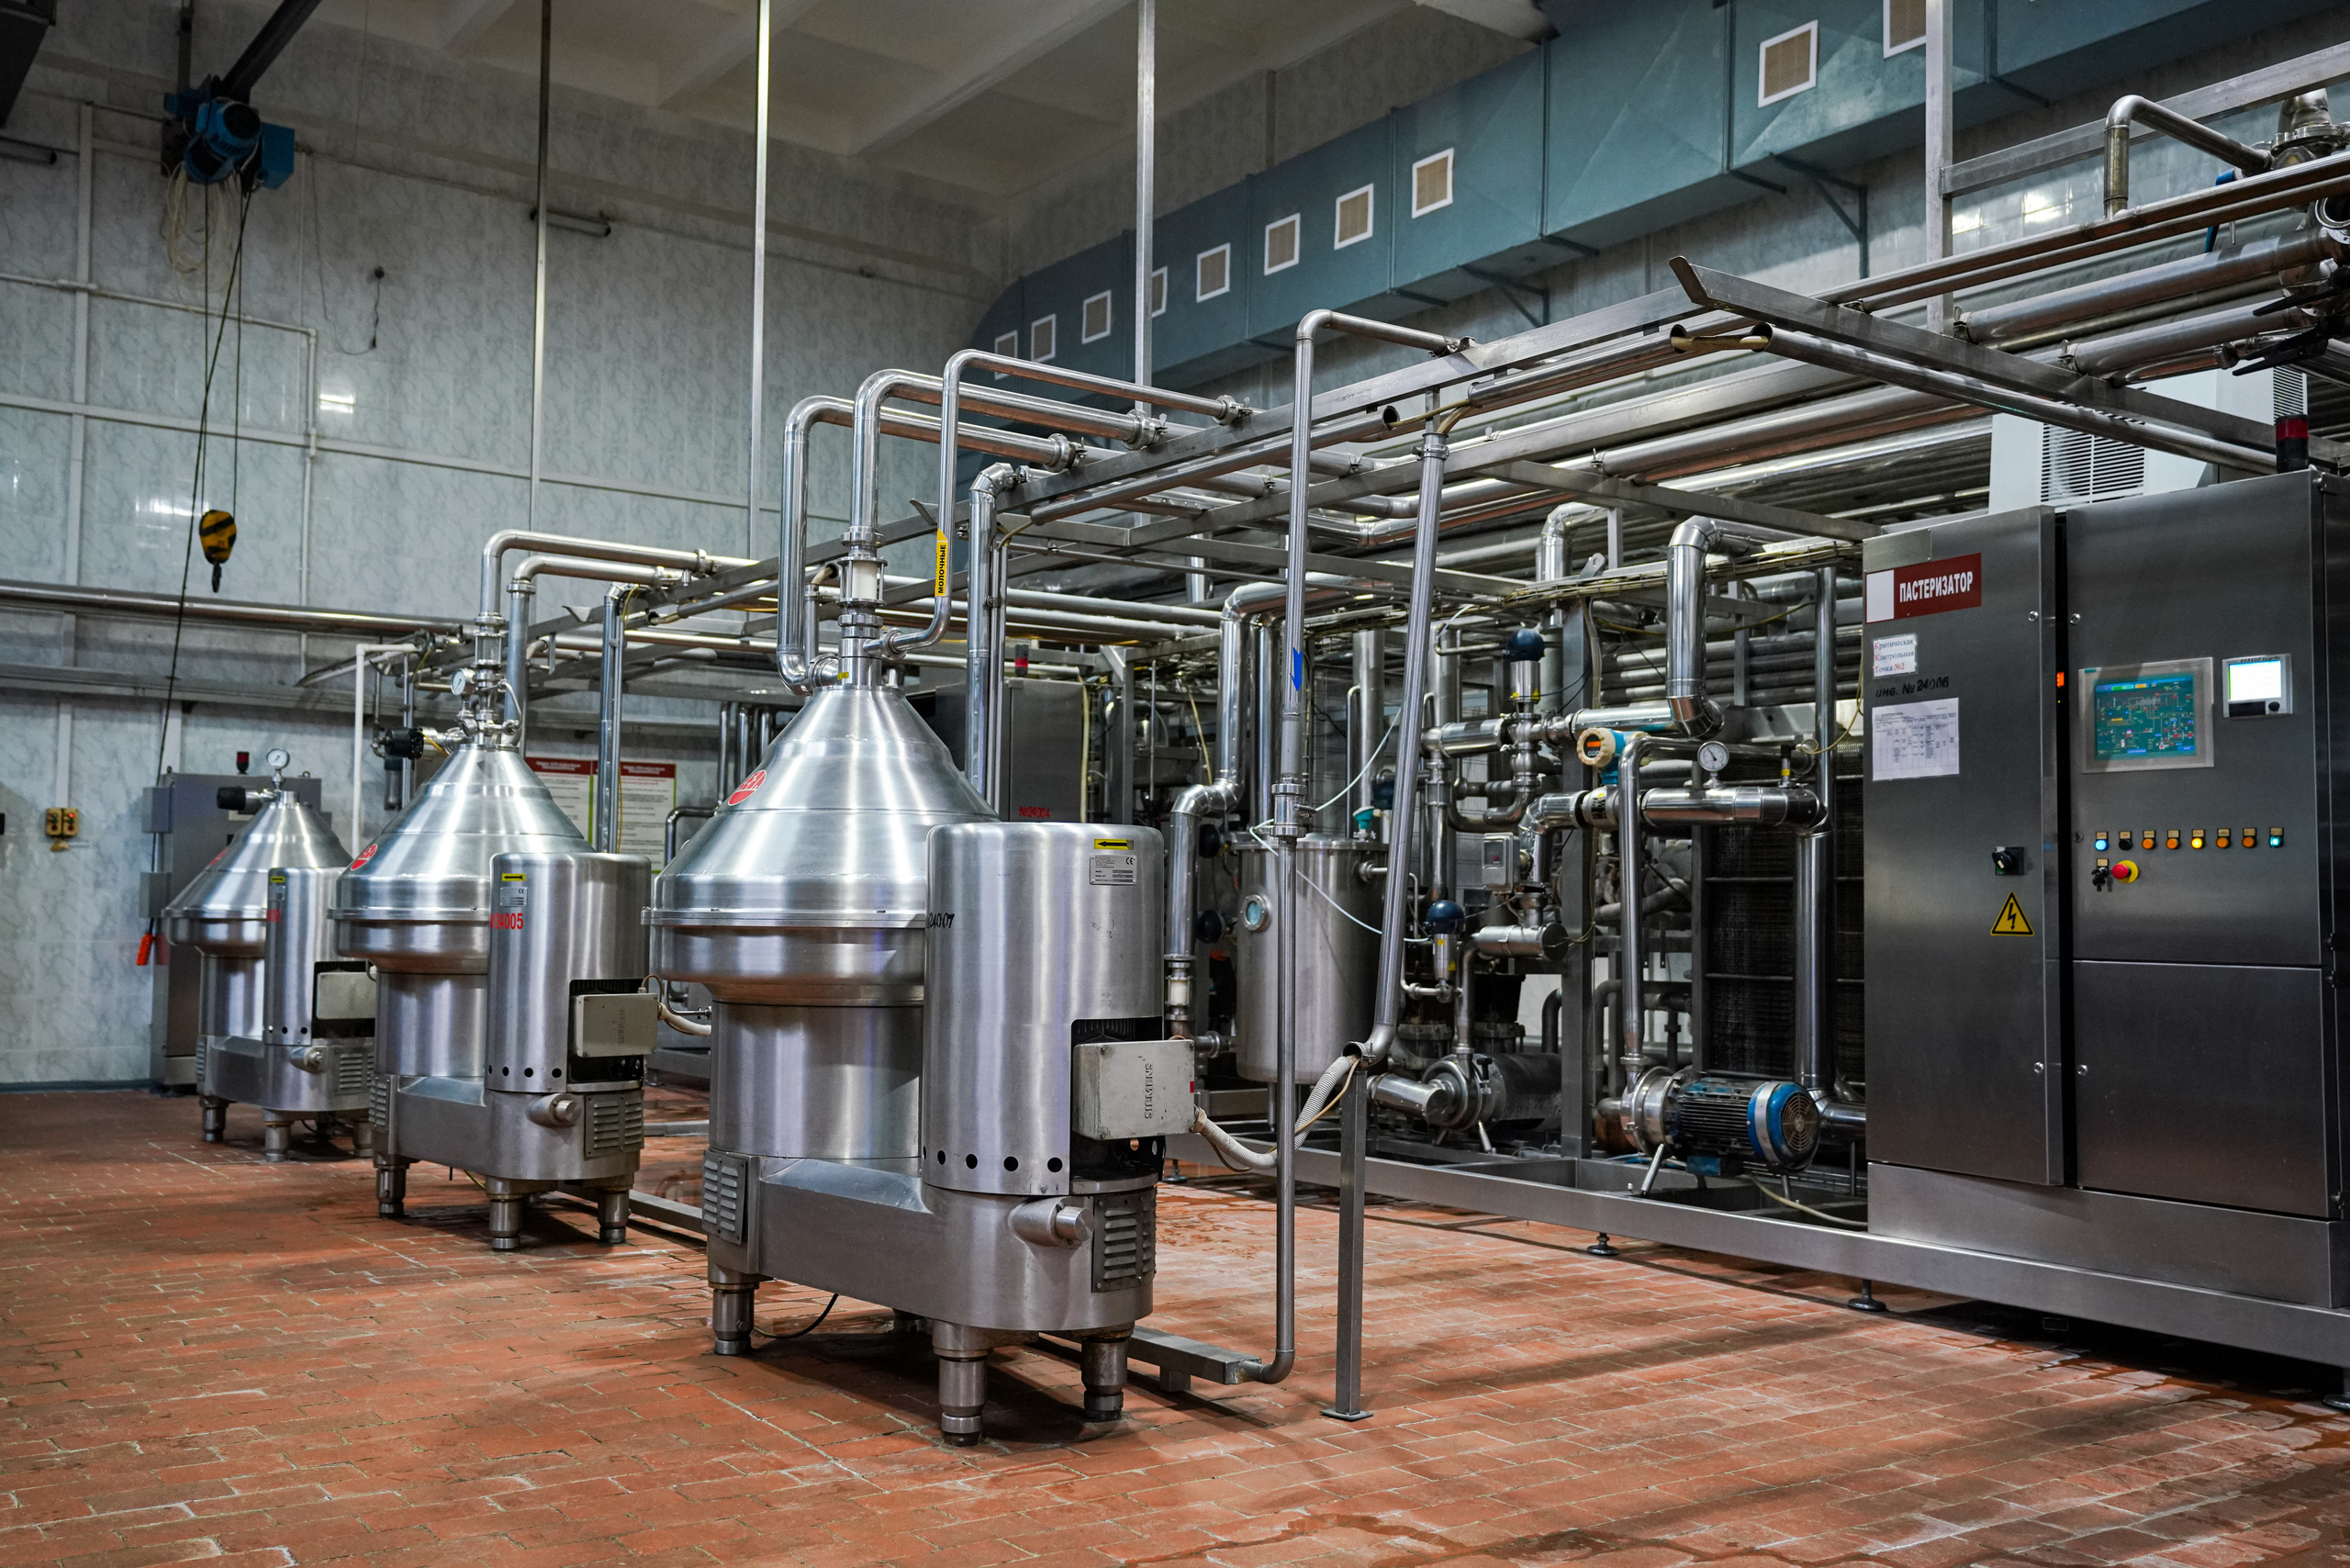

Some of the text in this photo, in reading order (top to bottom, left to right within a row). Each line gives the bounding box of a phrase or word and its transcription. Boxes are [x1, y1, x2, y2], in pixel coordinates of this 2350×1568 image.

[937, 544, 946, 594] МОЛОЧНЫЕ
[1899, 571, 1973, 602] ПАСТЕРИЗАТОР
[1874, 639, 1913, 650] Критическая
[1874, 650, 1915, 662] Контрольная
[1874, 662, 1905, 674] Точка №2
[1144, 1062, 1153, 1119] SIEMENS
